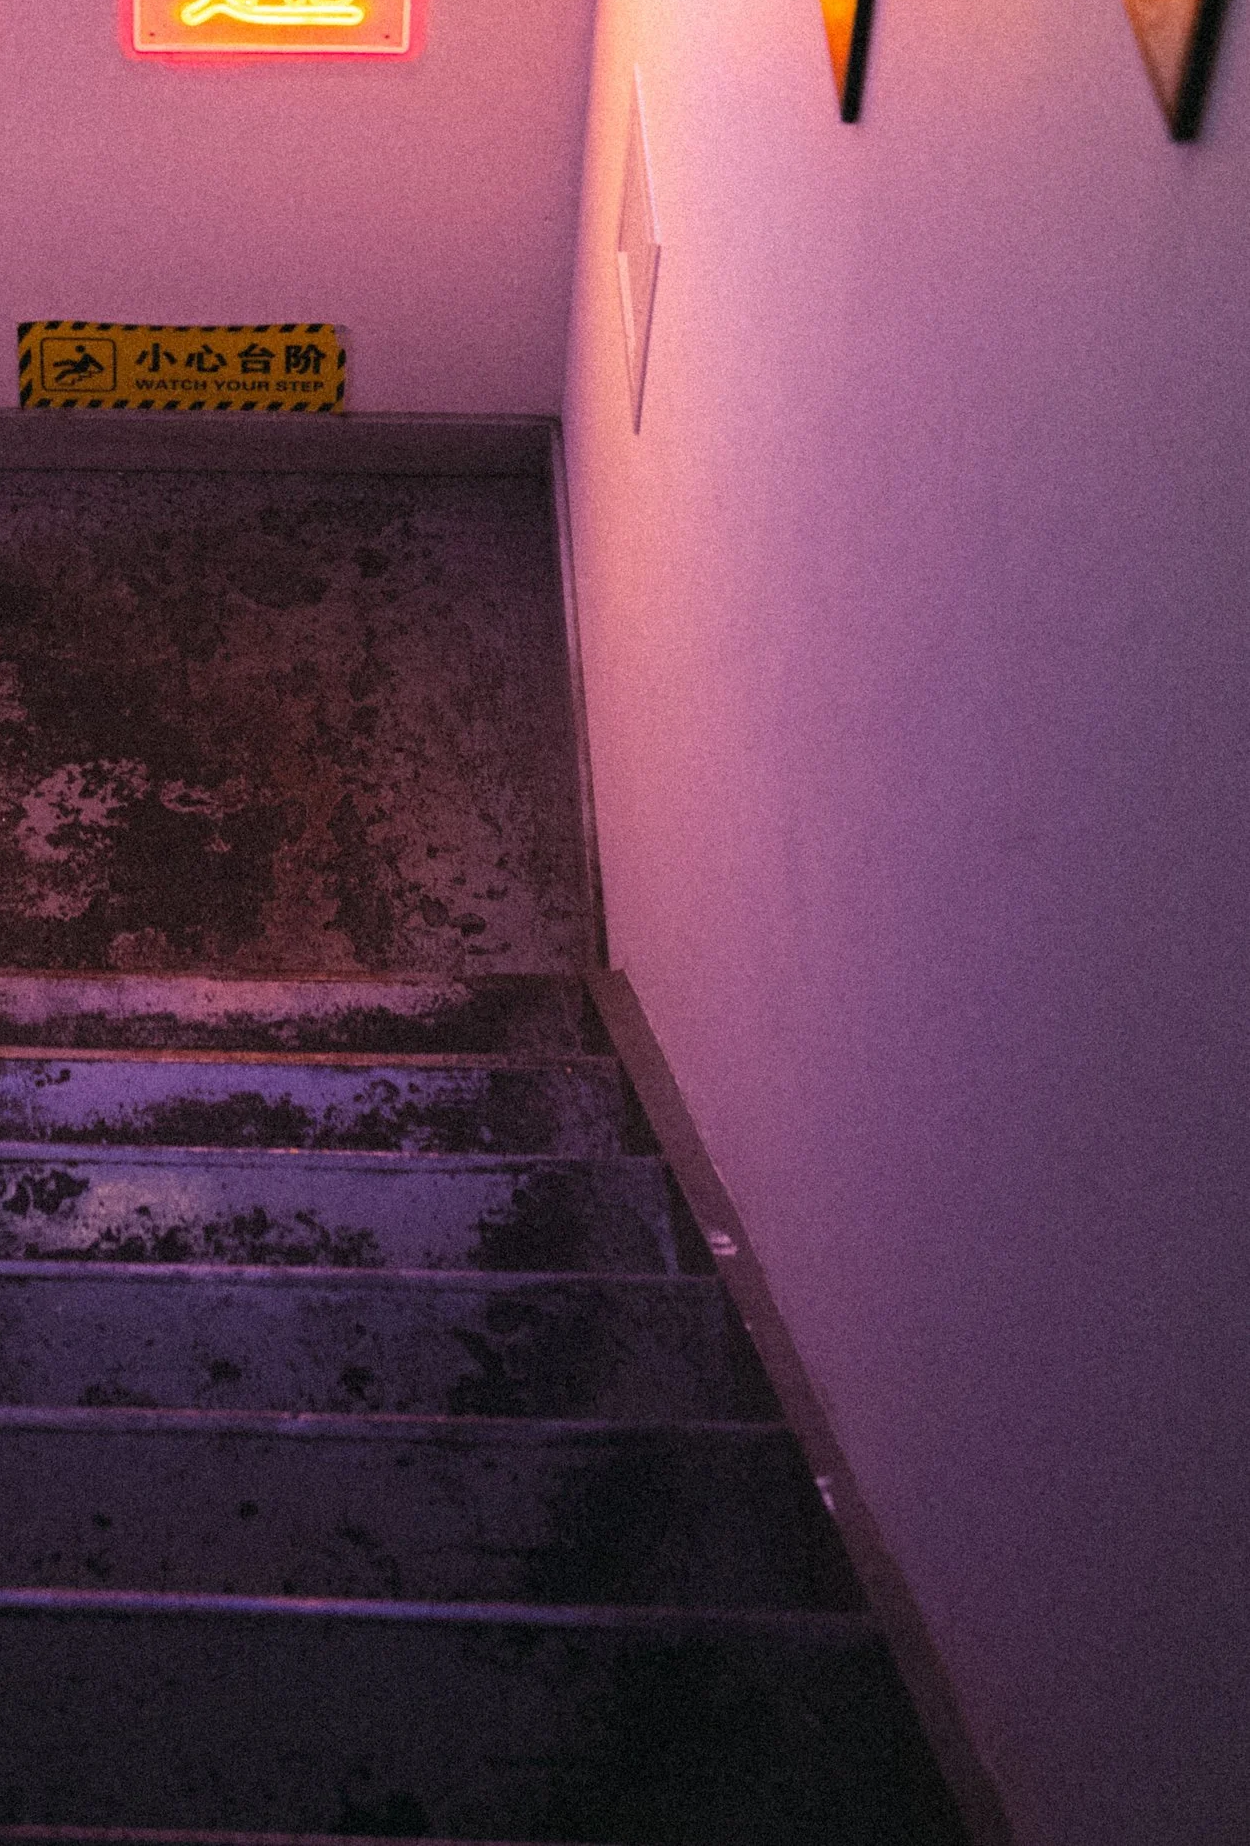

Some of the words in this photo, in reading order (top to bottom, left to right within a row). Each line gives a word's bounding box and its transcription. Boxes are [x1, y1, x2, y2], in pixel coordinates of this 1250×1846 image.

[134, 342, 327, 375] 小心台阶
[134, 377, 207, 392] WATCH
[216, 379, 270, 393] YOUR
[275, 380, 325, 393] STEP
